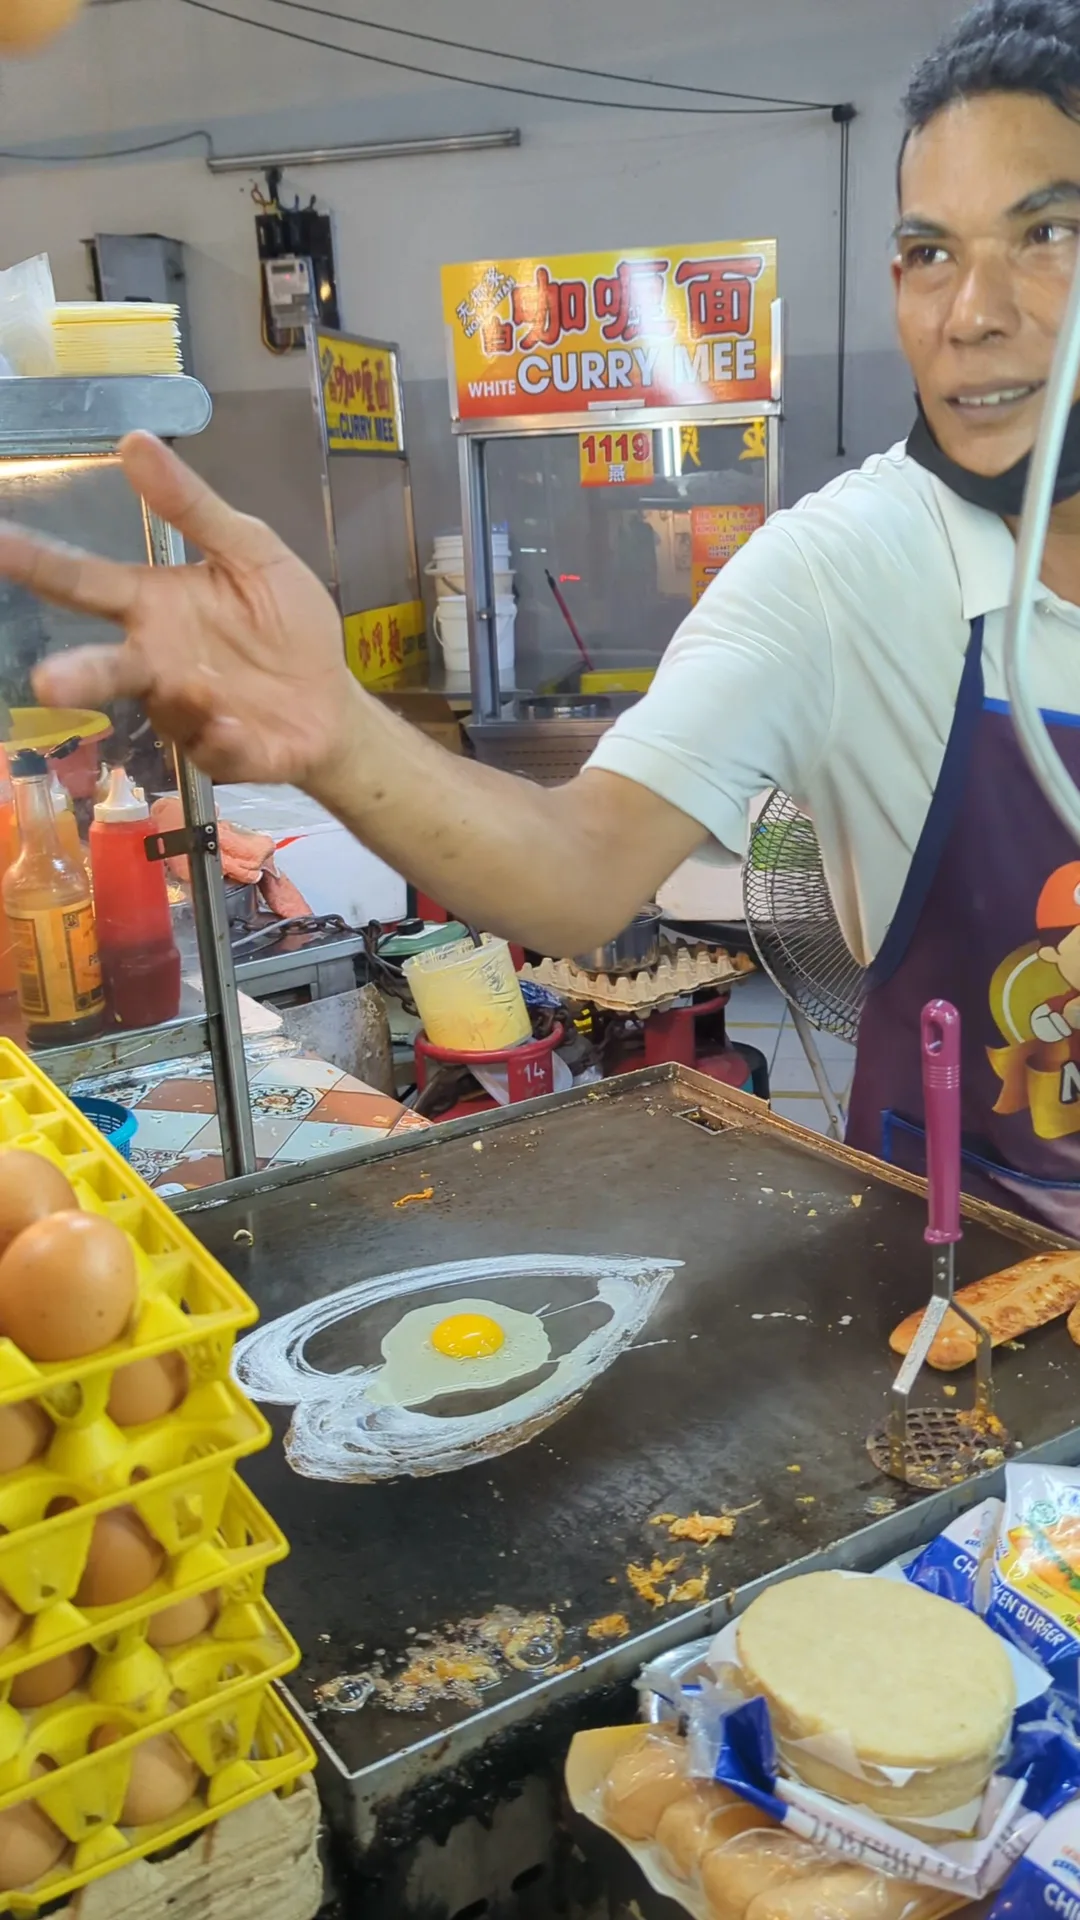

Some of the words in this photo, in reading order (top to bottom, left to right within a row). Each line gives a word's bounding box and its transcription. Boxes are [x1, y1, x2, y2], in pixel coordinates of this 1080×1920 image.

[468, 379, 516, 398] WHITE
[517, 346, 661, 395] CURRY
[673, 339, 757, 384] MEE
[582, 432, 650, 464] 1119
[524, 1062, 545, 1082] 14
[1015, 1603, 1067, 1647] BURGER
